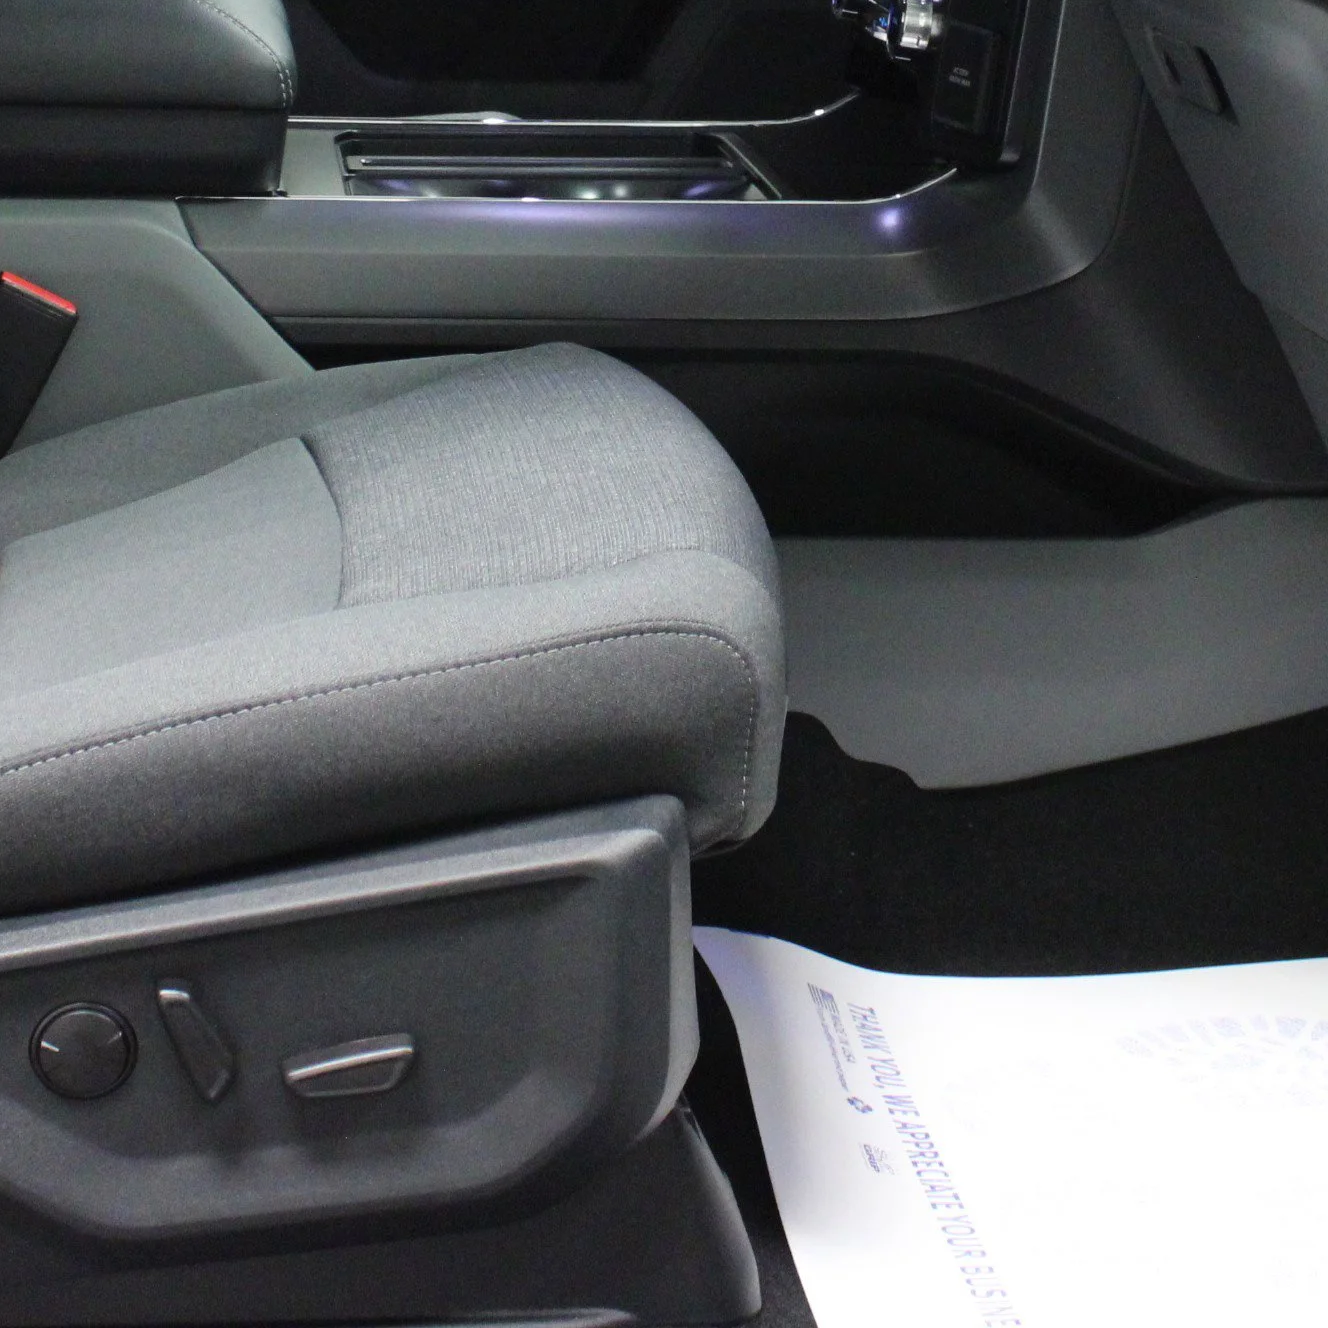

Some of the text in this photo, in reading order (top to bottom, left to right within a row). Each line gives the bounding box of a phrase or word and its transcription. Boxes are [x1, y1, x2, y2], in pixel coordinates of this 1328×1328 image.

[846, 1002, 892, 1054] THANK
[867, 1056, 907, 1089] YOU,
[881, 1094, 921, 1117] WE
[892, 1119, 965, 1210] APPRECIATE
[937, 1215, 987, 1259] YOUR
